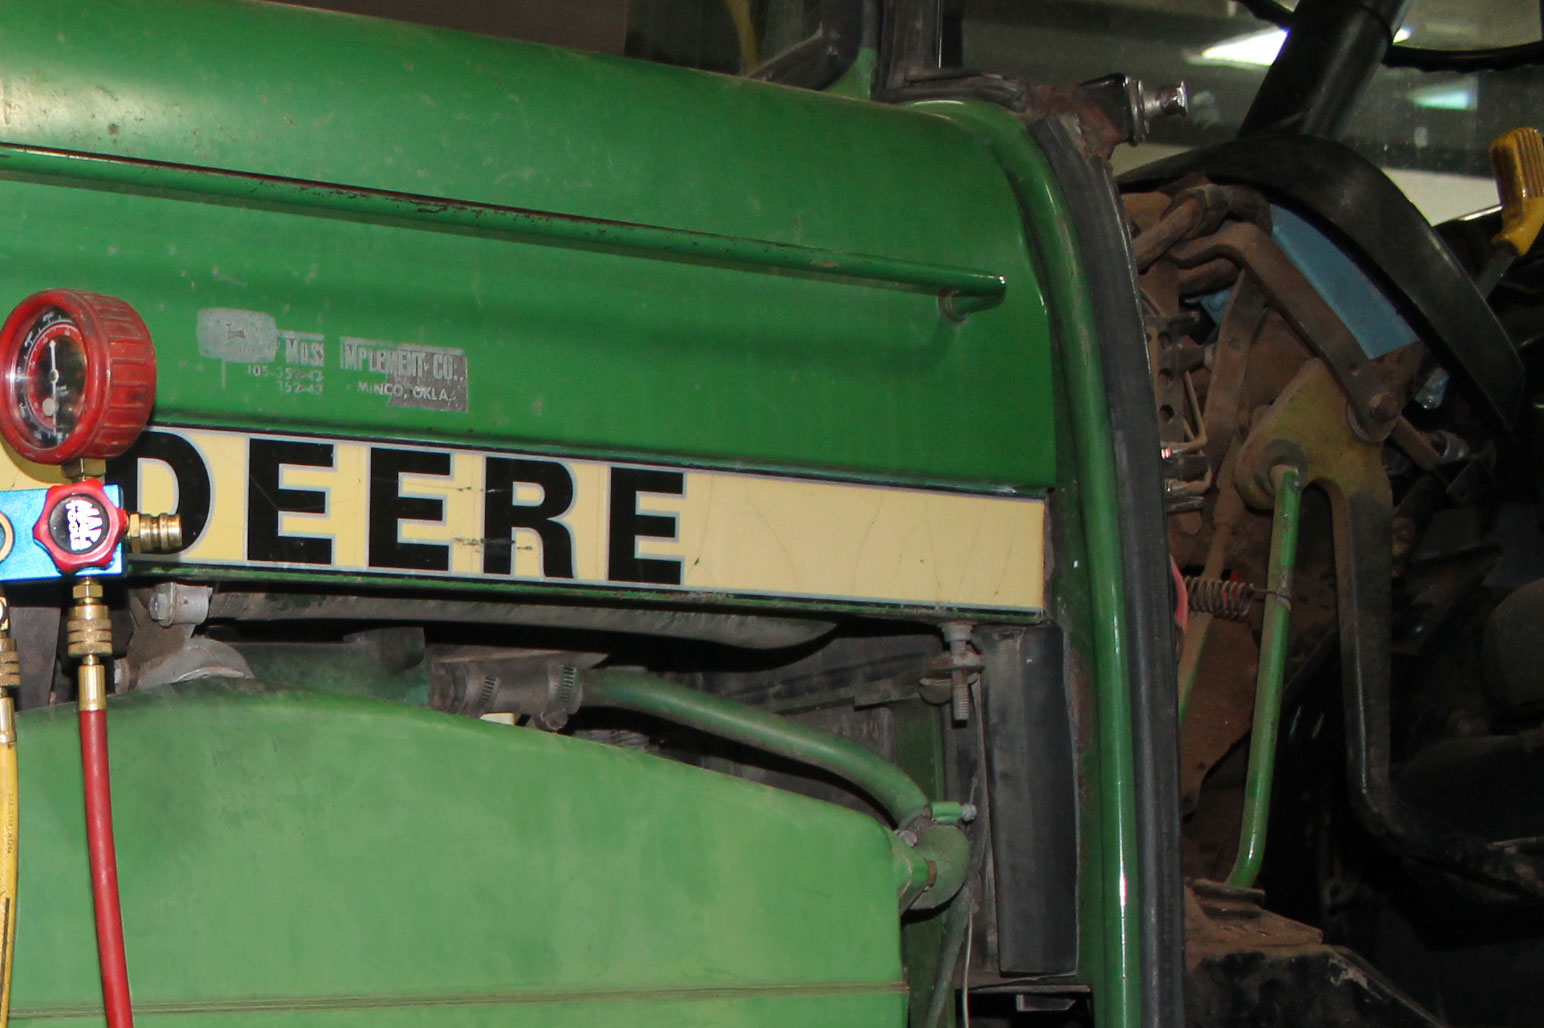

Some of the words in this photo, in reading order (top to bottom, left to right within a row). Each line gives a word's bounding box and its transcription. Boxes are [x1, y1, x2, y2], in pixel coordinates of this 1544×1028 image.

[340, 343, 426, 378] IMPLEMENT
[72, 499, 104, 550] MAC
[104, 429, 684, 586] DEERE
